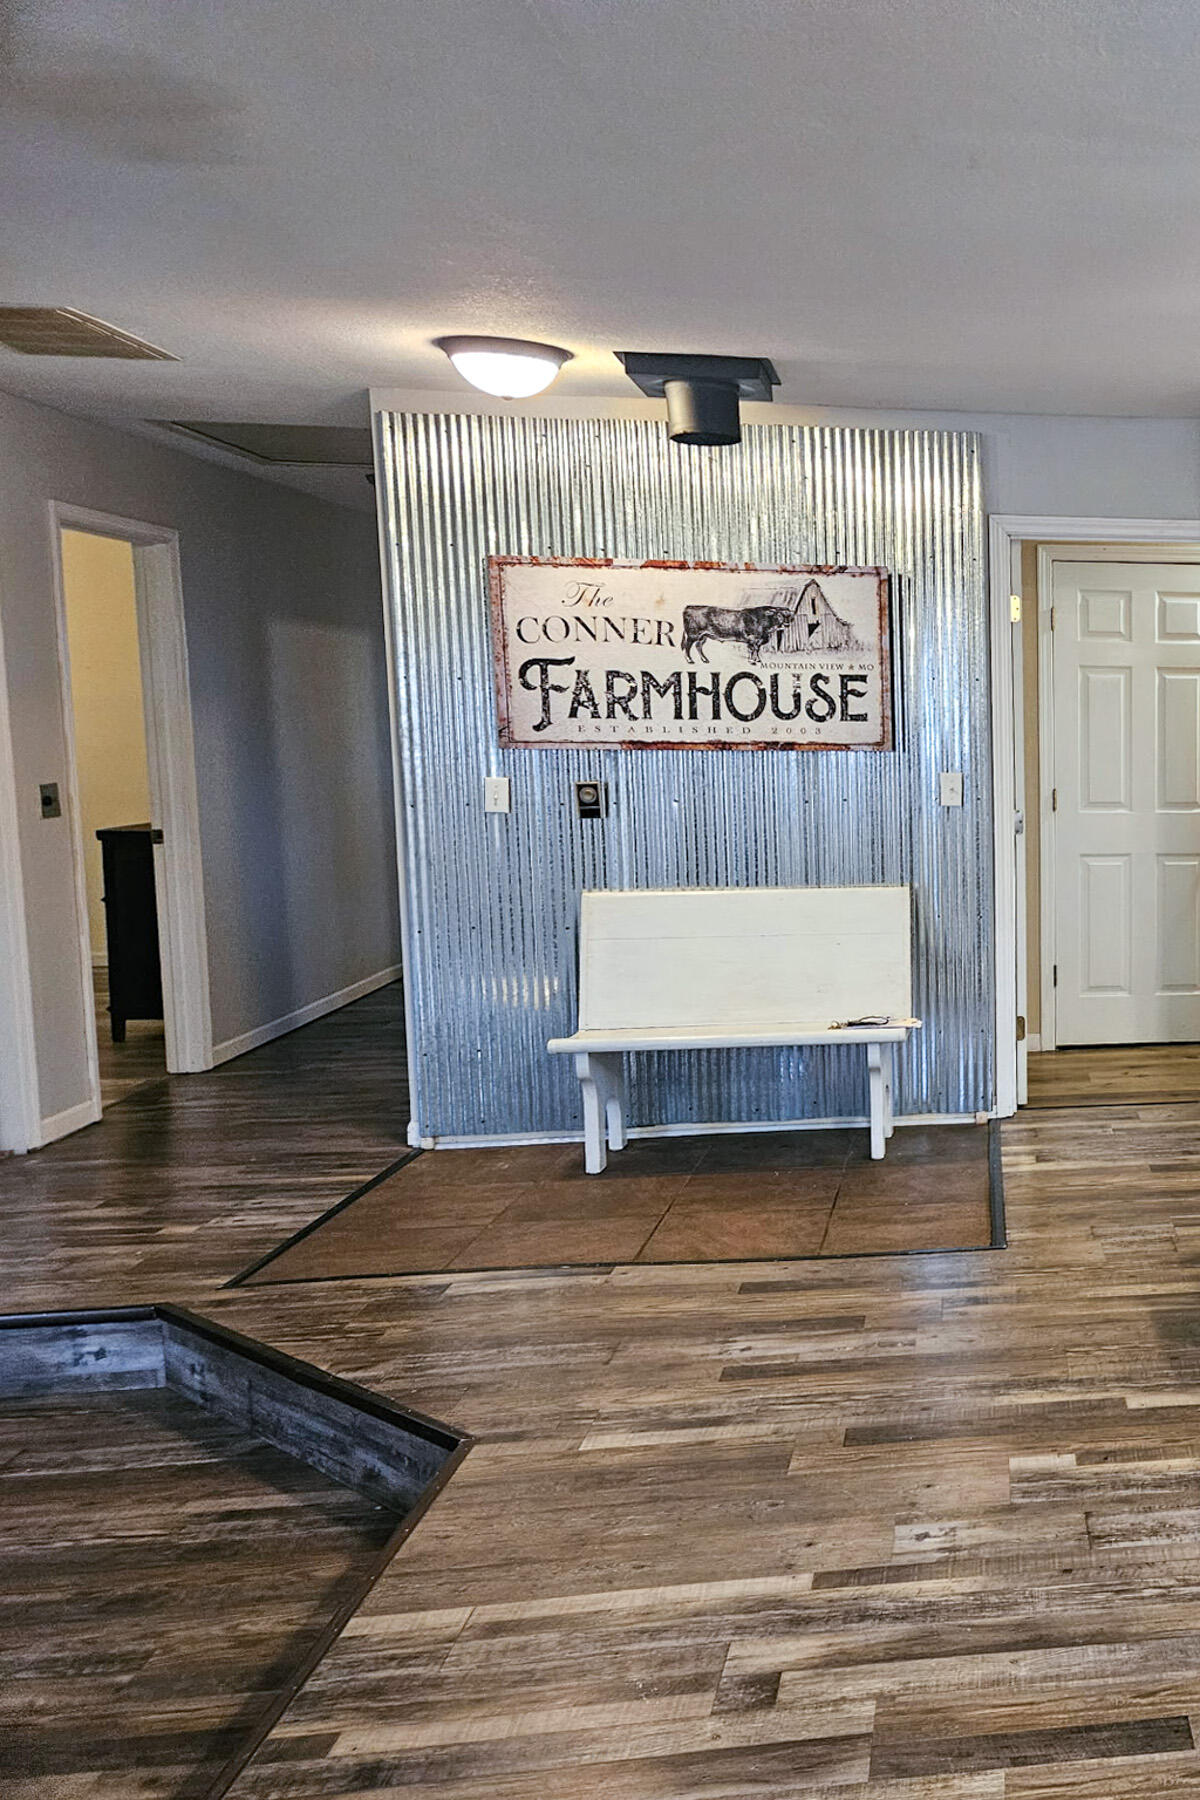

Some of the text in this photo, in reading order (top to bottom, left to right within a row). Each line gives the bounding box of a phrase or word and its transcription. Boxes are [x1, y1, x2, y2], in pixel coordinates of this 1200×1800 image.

[561, 580, 614, 608] The
[516, 615, 677, 647] CONNER
[760, 662, 816, 670] MOUNTAIN
[819, 663, 844, 671] VIEW
[518, 656, 869, 732] FARMHOUSE
[577, 724, 822, 735] ESTABLISHED 2003
